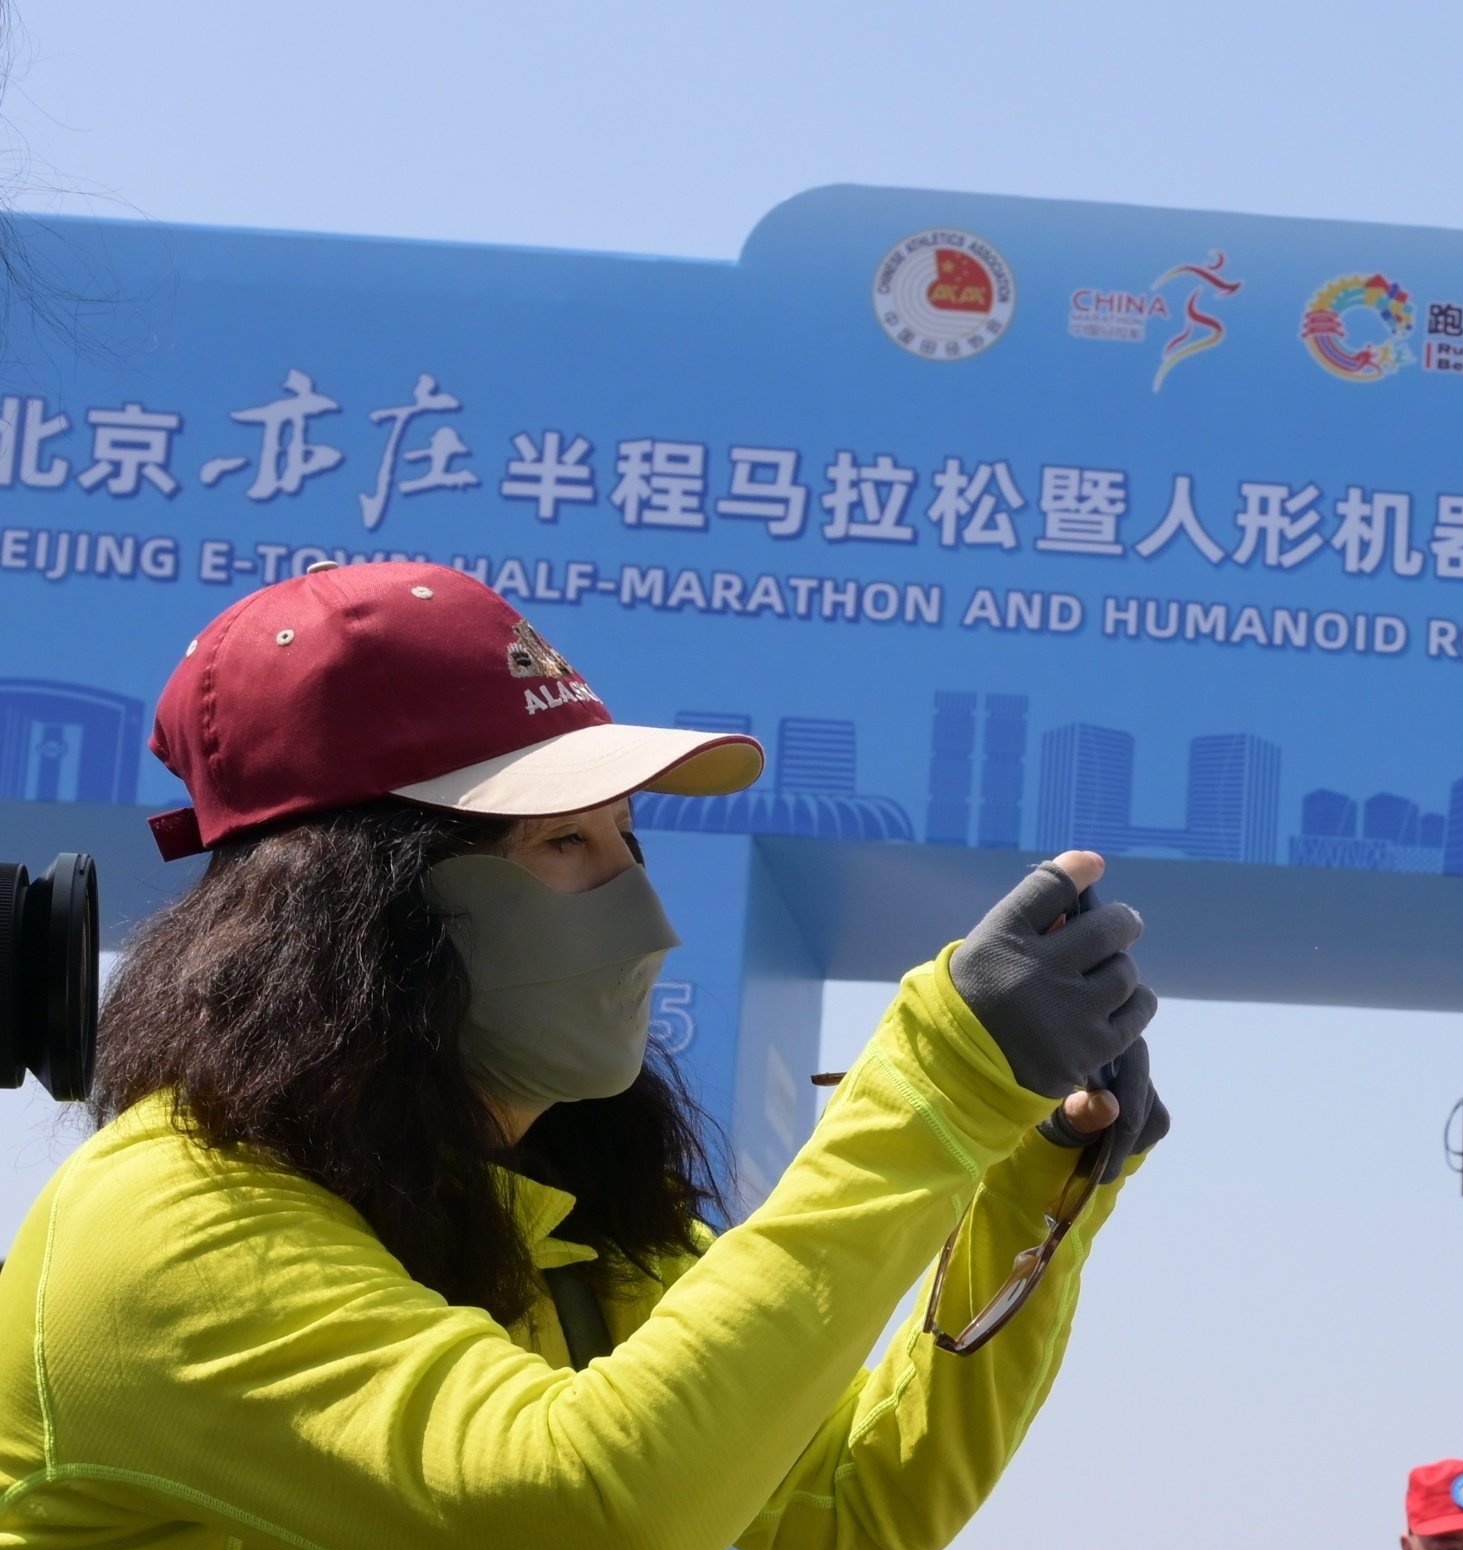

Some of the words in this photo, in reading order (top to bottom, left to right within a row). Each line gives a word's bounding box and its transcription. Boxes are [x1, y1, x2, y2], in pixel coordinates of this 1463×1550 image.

[1073, 290, 1168, 317] CHINA
[963, 588, 1083, 633] AND
[1103, 598, 1408, 656] HUMANOID
